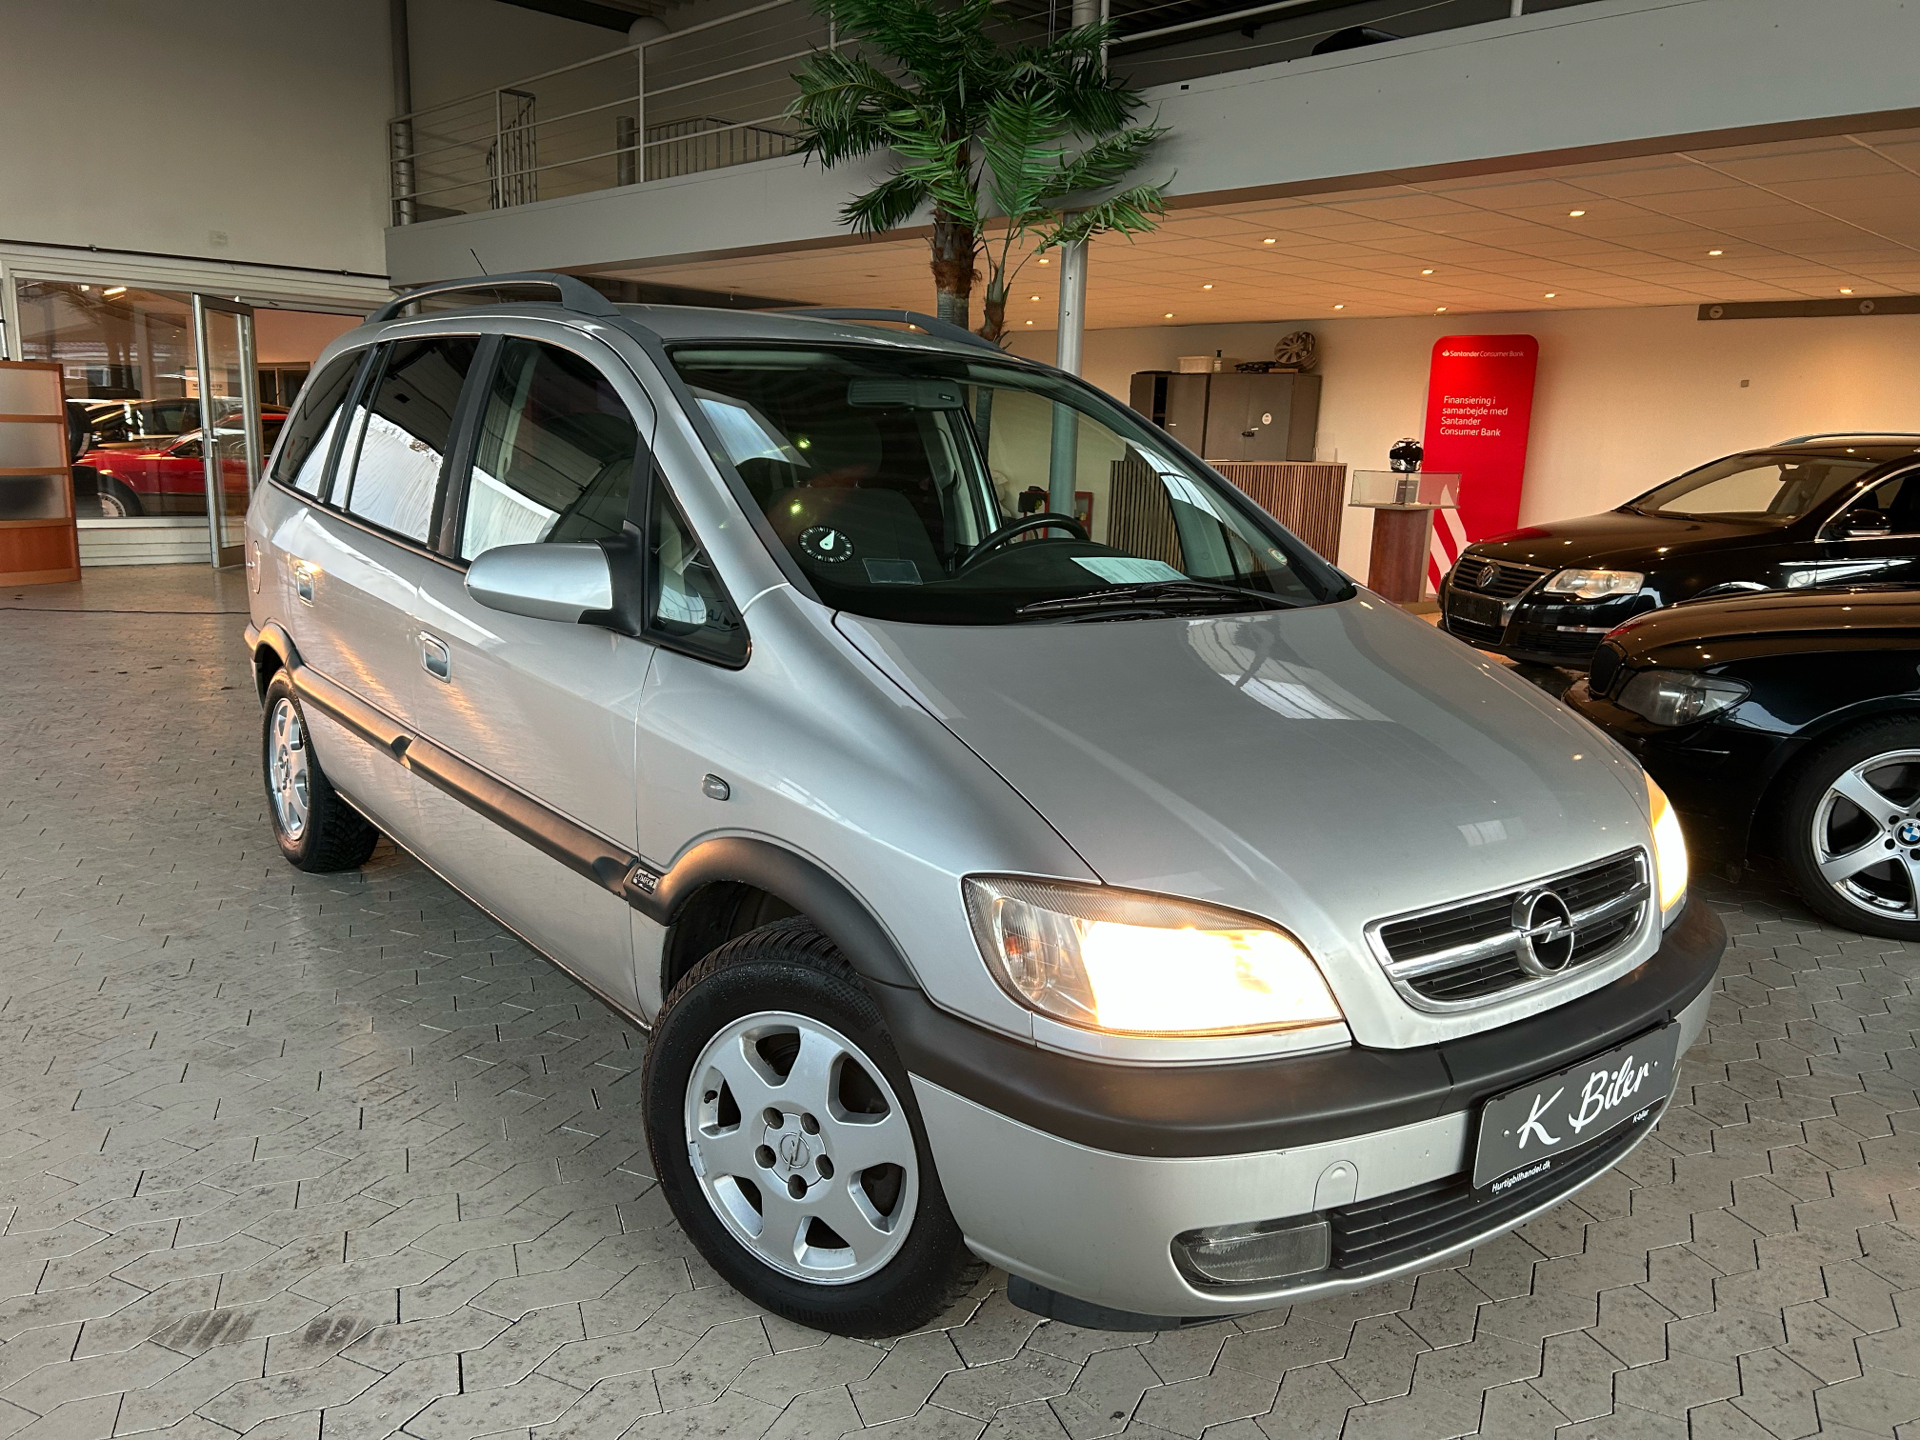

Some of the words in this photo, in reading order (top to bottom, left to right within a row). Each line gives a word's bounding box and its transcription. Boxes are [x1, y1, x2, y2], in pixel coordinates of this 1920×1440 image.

[1443, 395, 1491, 406] Finansiering
[1442, 407, 1488, 416] samarbejde
[1489, 407, 1508, 415] med
[1441, 416, 1481, 425] Santander
[1440, 427, 1479, 436] Consumer
[1480, 428, 1501, 436] Bank
[1516, 1086, 1565, 1149] K
[1568, 1055, 1650, 1134] Biler
[1491, 1160, 1551, 1193] Hurtigbilhandel.dk
